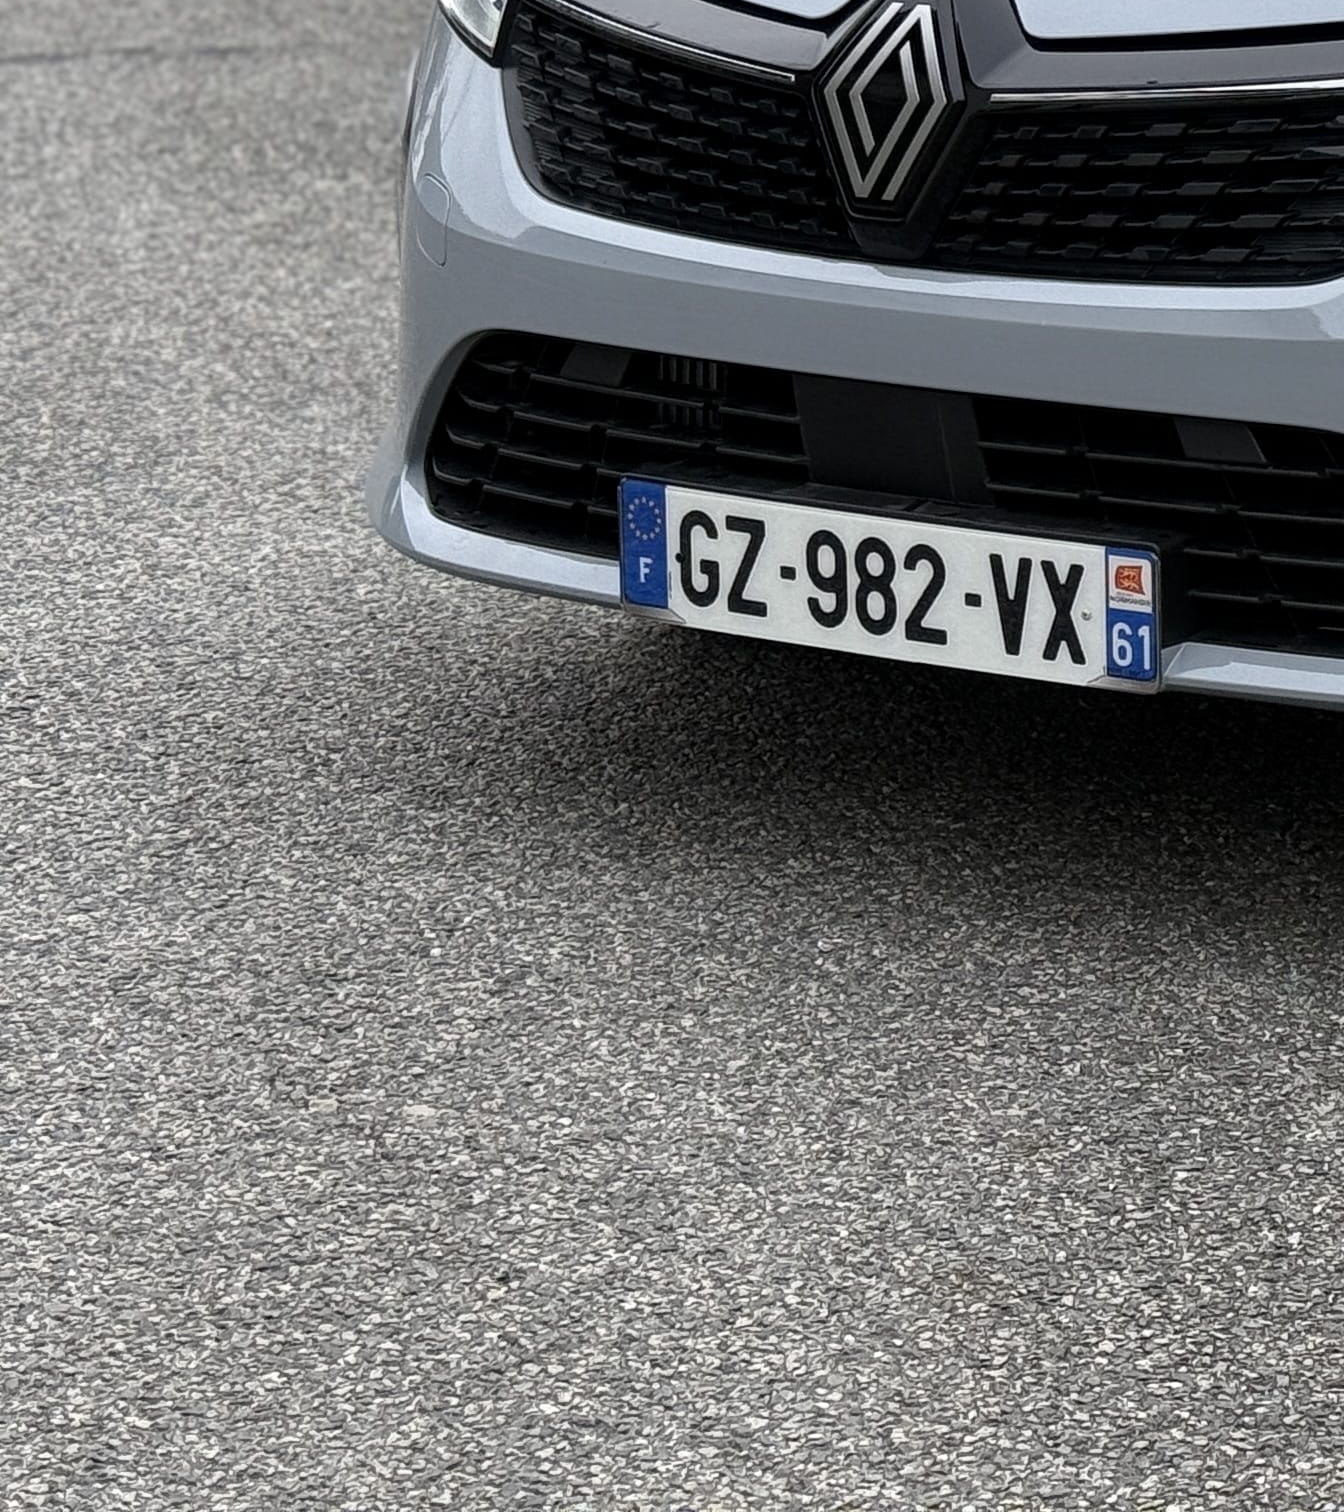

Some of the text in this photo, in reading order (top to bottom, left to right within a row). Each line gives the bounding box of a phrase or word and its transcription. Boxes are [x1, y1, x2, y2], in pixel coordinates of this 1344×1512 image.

[639, 556, 653, 584] F
[678, 510, 1087, 666] GZ-982-VX
[1112, 621, 1152, 671] 61
